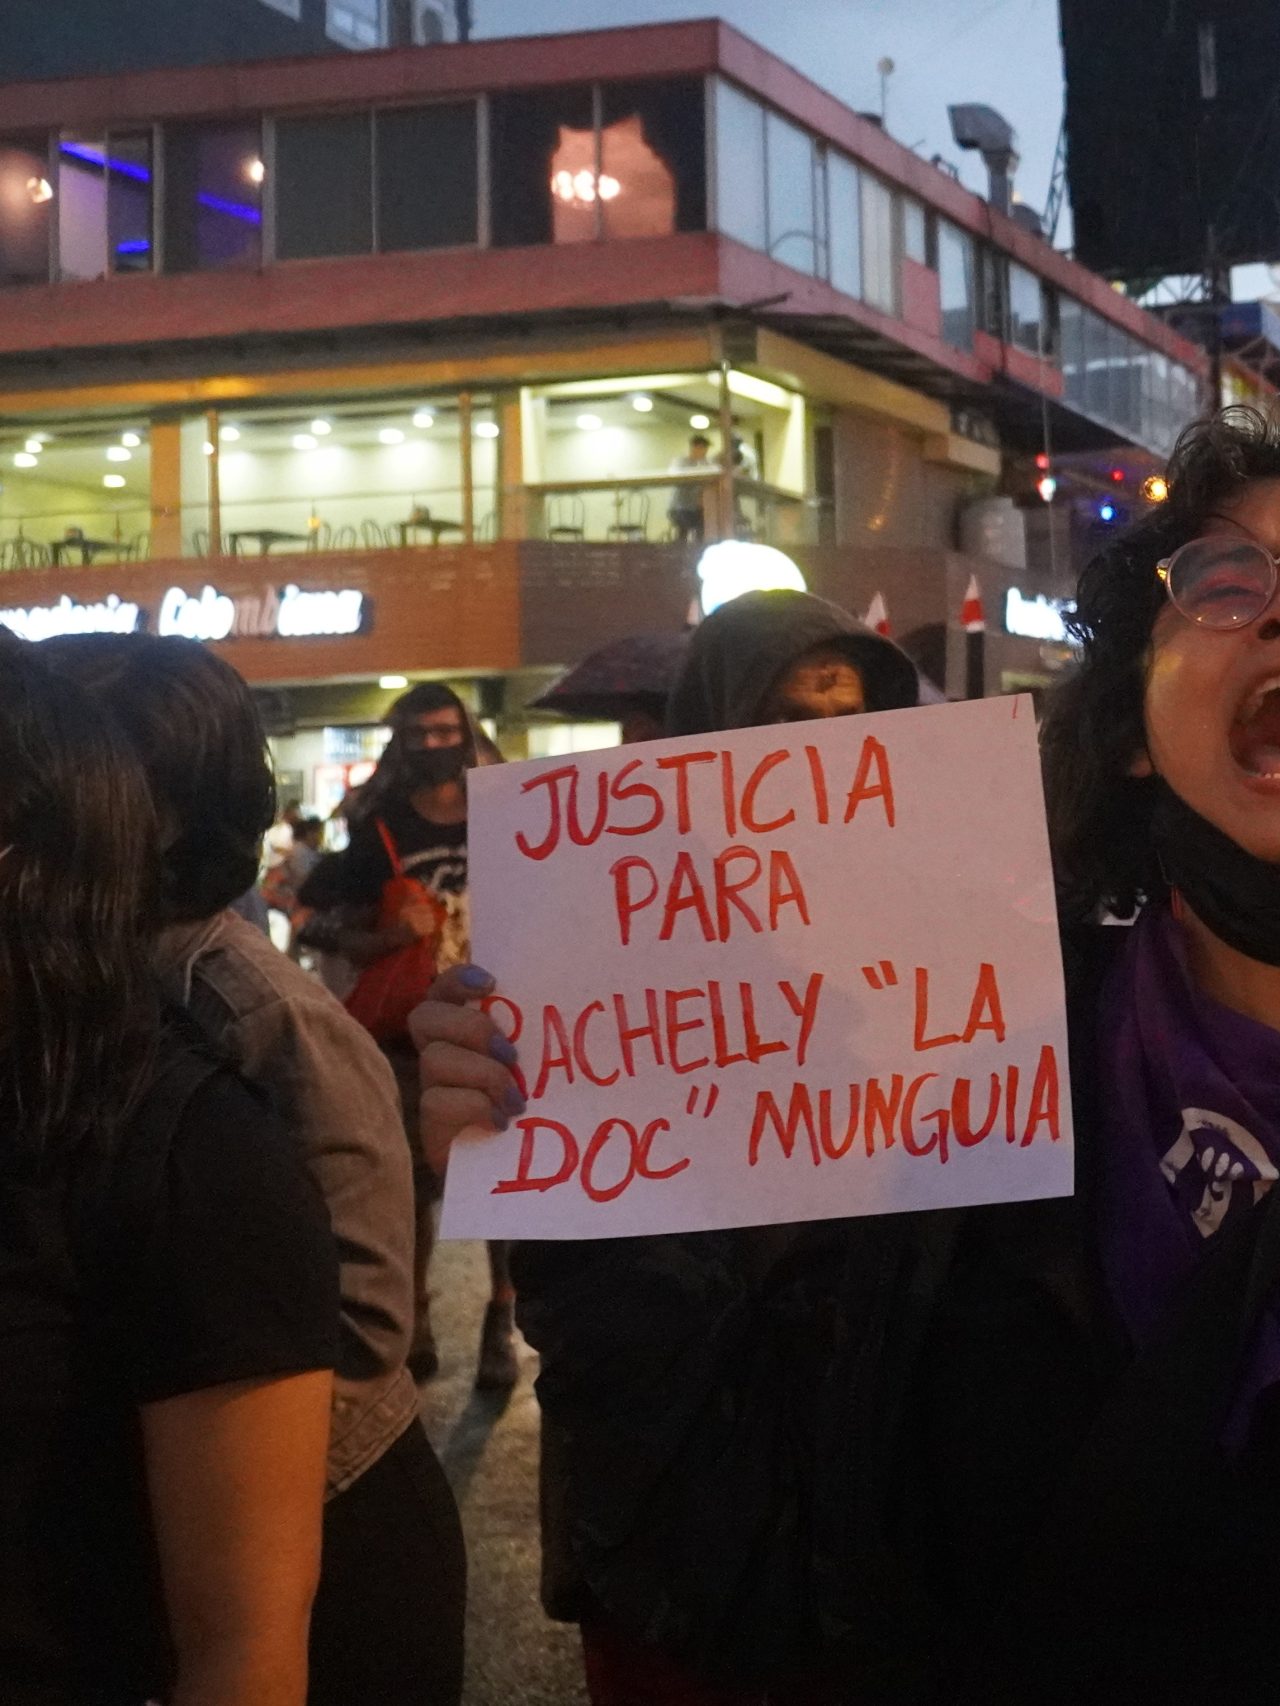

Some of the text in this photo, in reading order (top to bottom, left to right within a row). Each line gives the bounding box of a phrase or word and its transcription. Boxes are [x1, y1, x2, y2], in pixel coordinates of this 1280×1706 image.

[515, 735, 895, 861] JUSTICIA
[608, 845, 811, 946] PARA
[749, 1044, 1061, 1167] MUNGUIA
